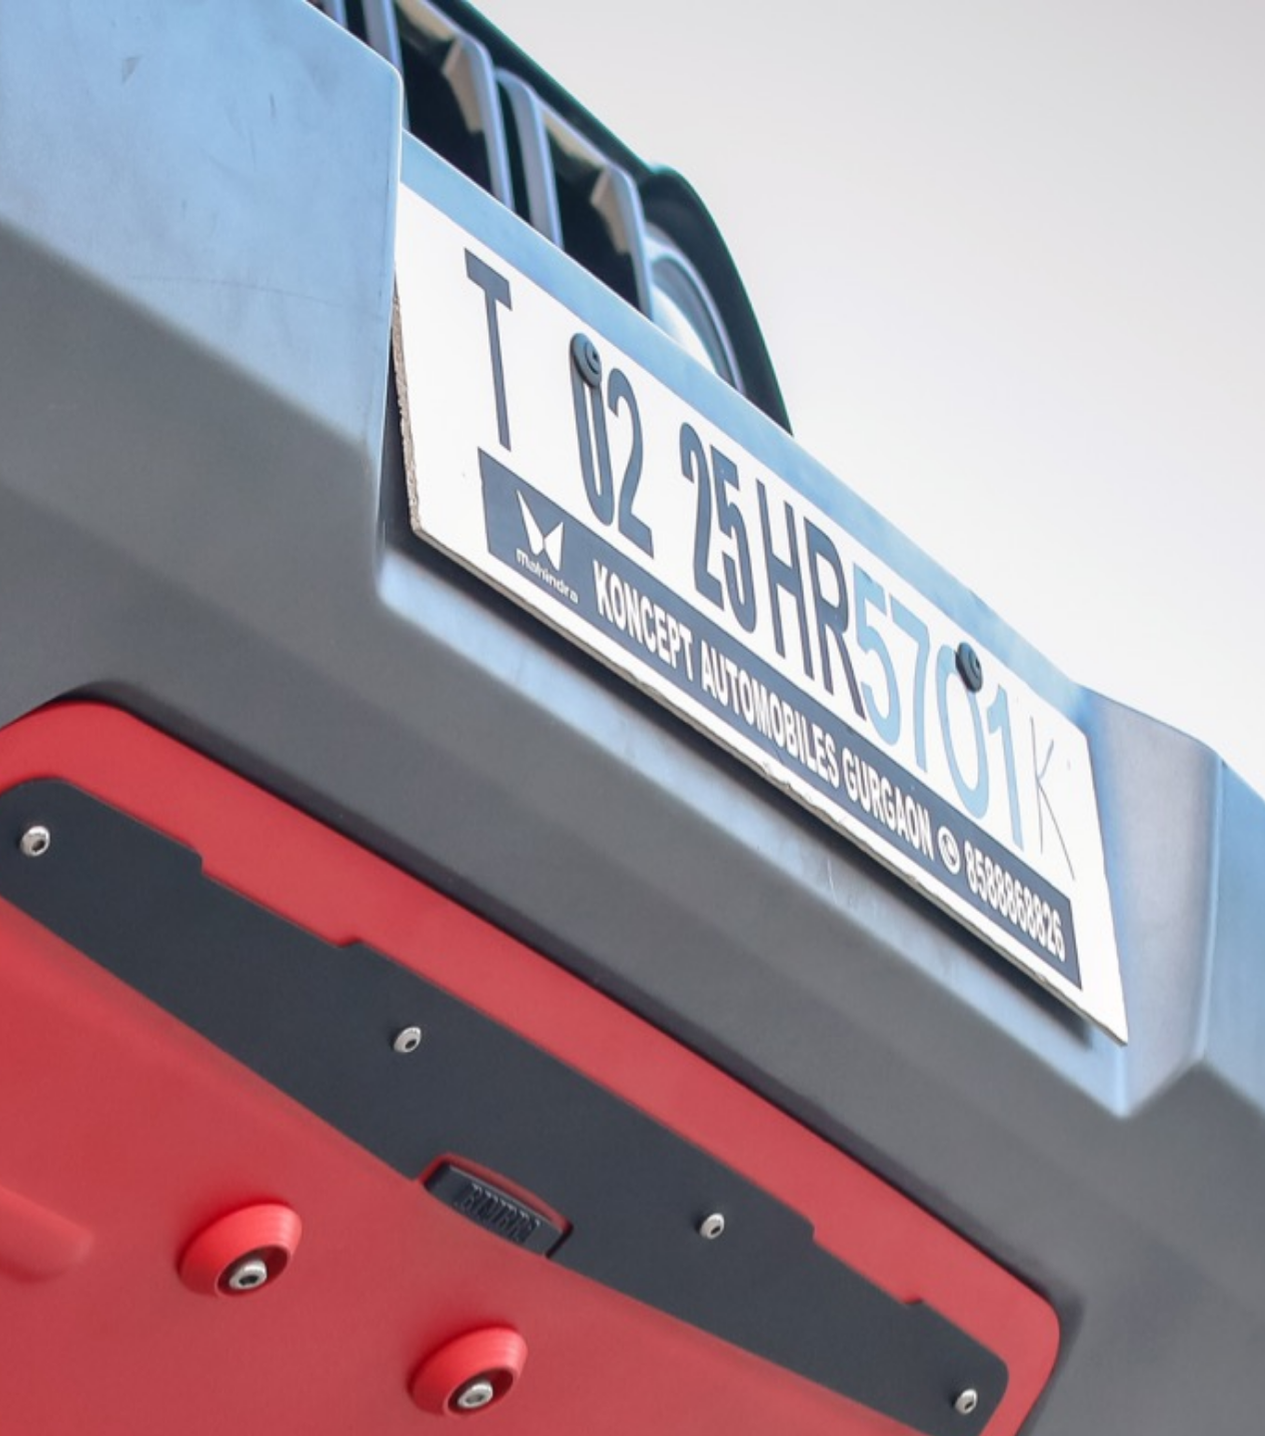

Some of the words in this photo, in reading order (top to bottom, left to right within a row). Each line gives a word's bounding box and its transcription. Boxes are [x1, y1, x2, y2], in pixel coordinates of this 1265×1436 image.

[463, 247, 513, 453] T
[570, 342, 655, 561] 02
[514, 547, 579, 605] mahindra
[592, 558, 695, 682] KONCEPT
[700, 639, 841, 789] AUTOMOBILES
[841, 745, 935, 862] GURGAON
